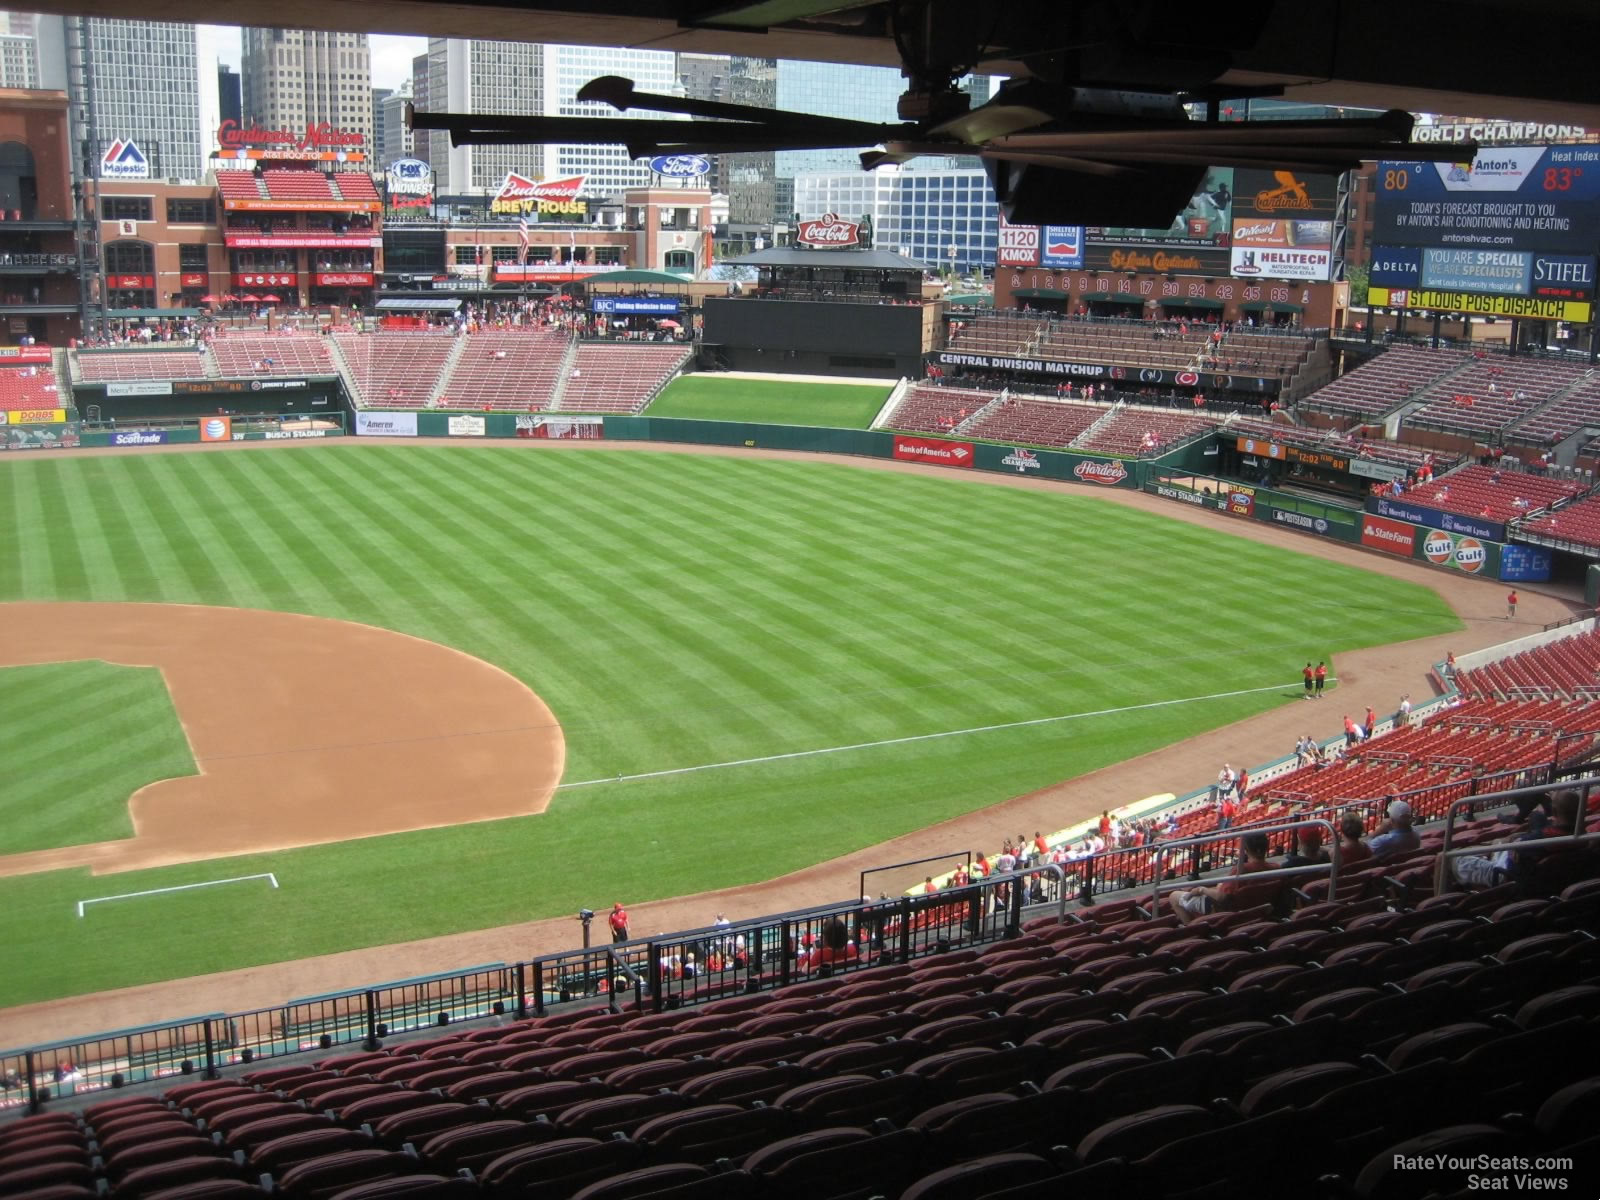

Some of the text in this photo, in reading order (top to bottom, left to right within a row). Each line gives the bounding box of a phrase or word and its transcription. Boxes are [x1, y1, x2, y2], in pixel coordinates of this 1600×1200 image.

[218, 120, 364, 149] Cardinals Nation
[1470, 123, 1585, 141] CHAMPIONS
[263, 150, 323, 160] AT&T ROOFTOP
[1552, 151, 1599, 162] Heat Index
[104, 163, 146, 174] Majestic
[400, 164, 421, 174] FOX
[662, 155, 700, 175] Ford
[1475, 159, 1517, 171] Anton's
[1384, 170, 1408, 190] 80
[388, 182, 434, 194] MIDWEST
[501, 180, 585, 198] Budweiser
[492, 200, 586, 214] BREW HOUSE
[1411, 202, 1555, 217] TODAY'S FORECAST BROUGHT TO YOU
[1397, 215, 1570, 231] BY ANTON'S AIR CONDITIONING AND HEATING
[805, 223, 850, 241] Coca-Cola
[1002, 231, 1036, 247] 1120
[1442, 234, 1513, 244] antonshvac.com
[1001, 249, 1035, 261] KMOX
[1261, 252, 1327, 265] HELITECH
[1429, 249, 1525, 267] YOU ARE SPECIAL
[1383, 262, 1417, 272] DELTA
[1429, 263, 1523, 279] WE ARE SPECIALISTS
[1534, 258, 1591, 282] STIFEL
[1079, 278, 1088, 291] 9
[1097, 279, 1109, 292] 10
[1118, 279, 1130, 293] 14
[1140, 280, 1153, 294] 17
[1163, 282, 1179, 296] 20
[1189, 284, 1205, 297] 24
[1216, 285, 1233, 299] 42
[1243, 286, 1260, 300] 45
[1271, 288, 1288, 302] 85
[1428, 276, 1514, 291] Saint Louis University Hospital
[596, 302, 612, 311] BJC
[616, 302, 634, 311] Making
[659, 303, 676, 311] Better
[1410, 292, 1565, 318] ST. LOUIS POST-DISPATCH
[940, 353, 1103, 376] CENTRAL DIVISION MATCHUP
[189, 383, 212, 392] 12:02
[262, 380, 306, 389] JIMMY JOHN'S
[20, 411, 55, 419] DOBBS
[366, 420, 393, 429] Ameren
[116, 433, 161, 444] Scottrade
[265, 430, 325, 439] BUSCH STADIUM
[1002, 458, 1041, 469] CHAMPIONS
[1299, 452, 1319, 464] 12:02
[1157, 486, 1203, 504] BUSCH STADIUM
[1228, 484, 1254, 496] STLFORD
[1284, 511, 1313, 528] POSTSEASON
[1389, 507, 1422, 523] Merrill Lynch
[1454, 522, 1490, 538] Merrill Lynch
[1426, 542, 1451, 553] Gulf
[1456, 549, 1483, 561] Gulf
